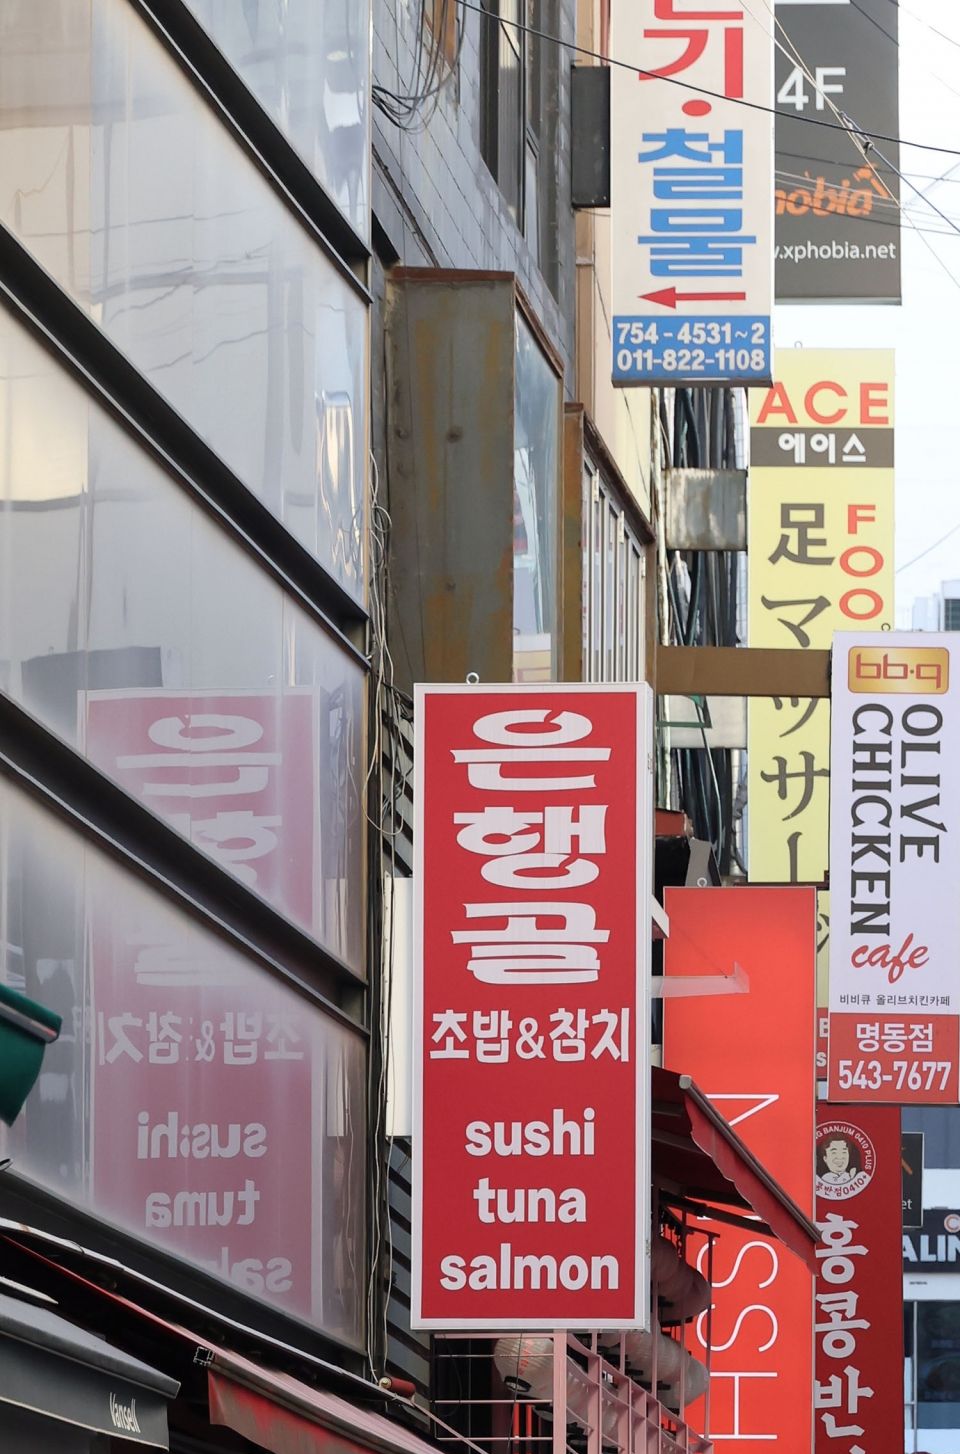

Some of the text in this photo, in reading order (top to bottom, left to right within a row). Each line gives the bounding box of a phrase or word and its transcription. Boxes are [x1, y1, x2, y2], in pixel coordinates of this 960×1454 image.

[777, 67, 846, 111] 4F
[617, 349, 765, 371] 011-822-1108
[757, 381, 889, 424] ACE
[778, 433, 866, 465] 에이스
[898, 703, 948, 864] OLIVE
[850, 703, 894, 937] CHICKEN
[450, 709, 612, 985] 은행골
[851, 933, 930, 984] cafe
[839, 994, 951, 1008] 비비큐 올리브치킨카페
[430, 1007, 631, 1064] 초밥&참치
[855, 1022, 934, 1053] 명동점
[838, 1060, 952, 1092] 543-7677
[465, 1107, 596, 1157] sushi
[472, 1177, 587, 1224] tuna
[440, 1242, 620, 1291] salmon
